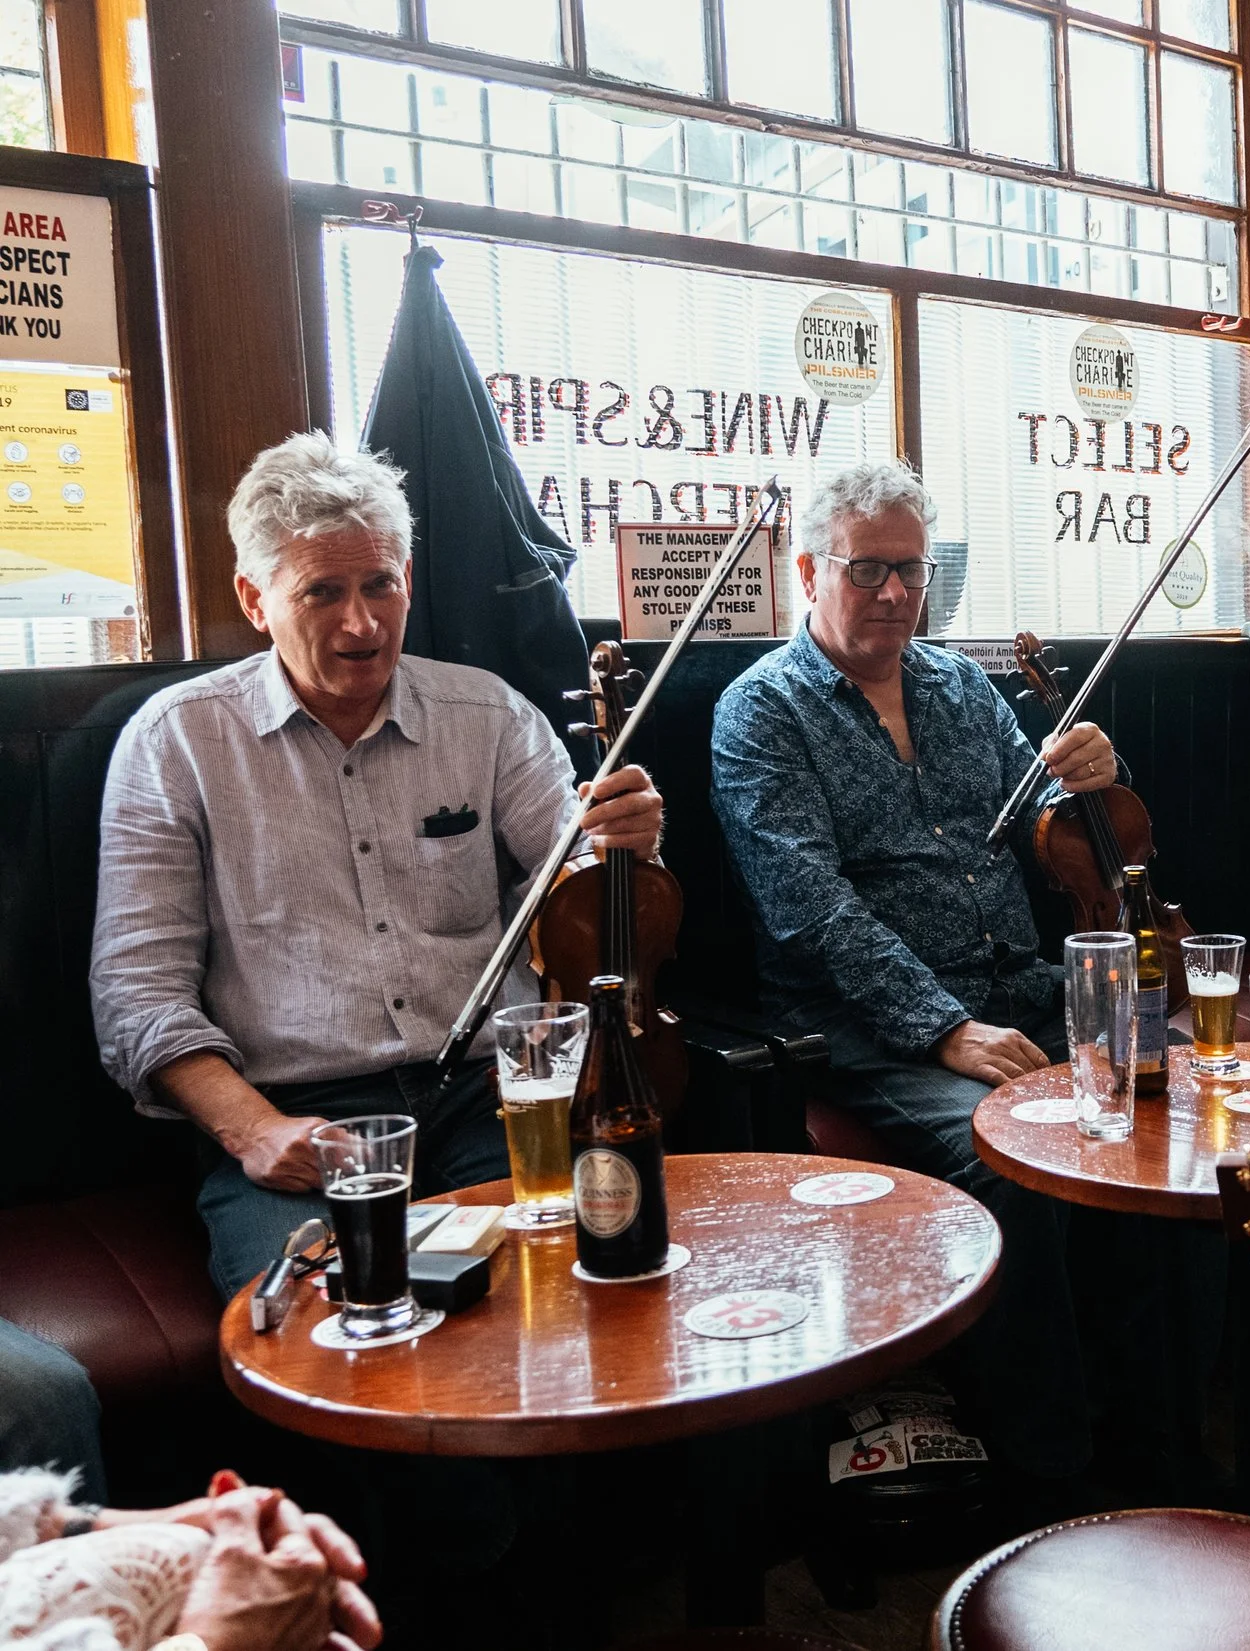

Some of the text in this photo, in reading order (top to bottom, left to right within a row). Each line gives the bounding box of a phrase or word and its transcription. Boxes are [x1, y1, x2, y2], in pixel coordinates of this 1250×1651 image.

[3, 211, 67, 242] AREA
[24, 317, 61, 339] YOU
[806, 364, 877, 380] PILSNER
[838, 381, 850, 389] that
[824, 389, 837, 397] from
[850, 391, 863, 399] Cold
[1079, 386, 1132, 401] PILSNER
[18, 425, 78, 436] coronavirus
[637, 533, 663, 545] THE
[662, 550, 710, 562] ACCEPT
[738, 567, 762, 579] FOR
[1179, 570, 1203, 583] Quality
[633, 585, 660, 598] ANY
[711, 584, 742, 596] OST
[746, 584, 762, 596] OR
[642, 602, 691, 615] STOLEN
[717, 601, 756, 613] THESE
[579, 1185, 633, 1198] GUINNESS
